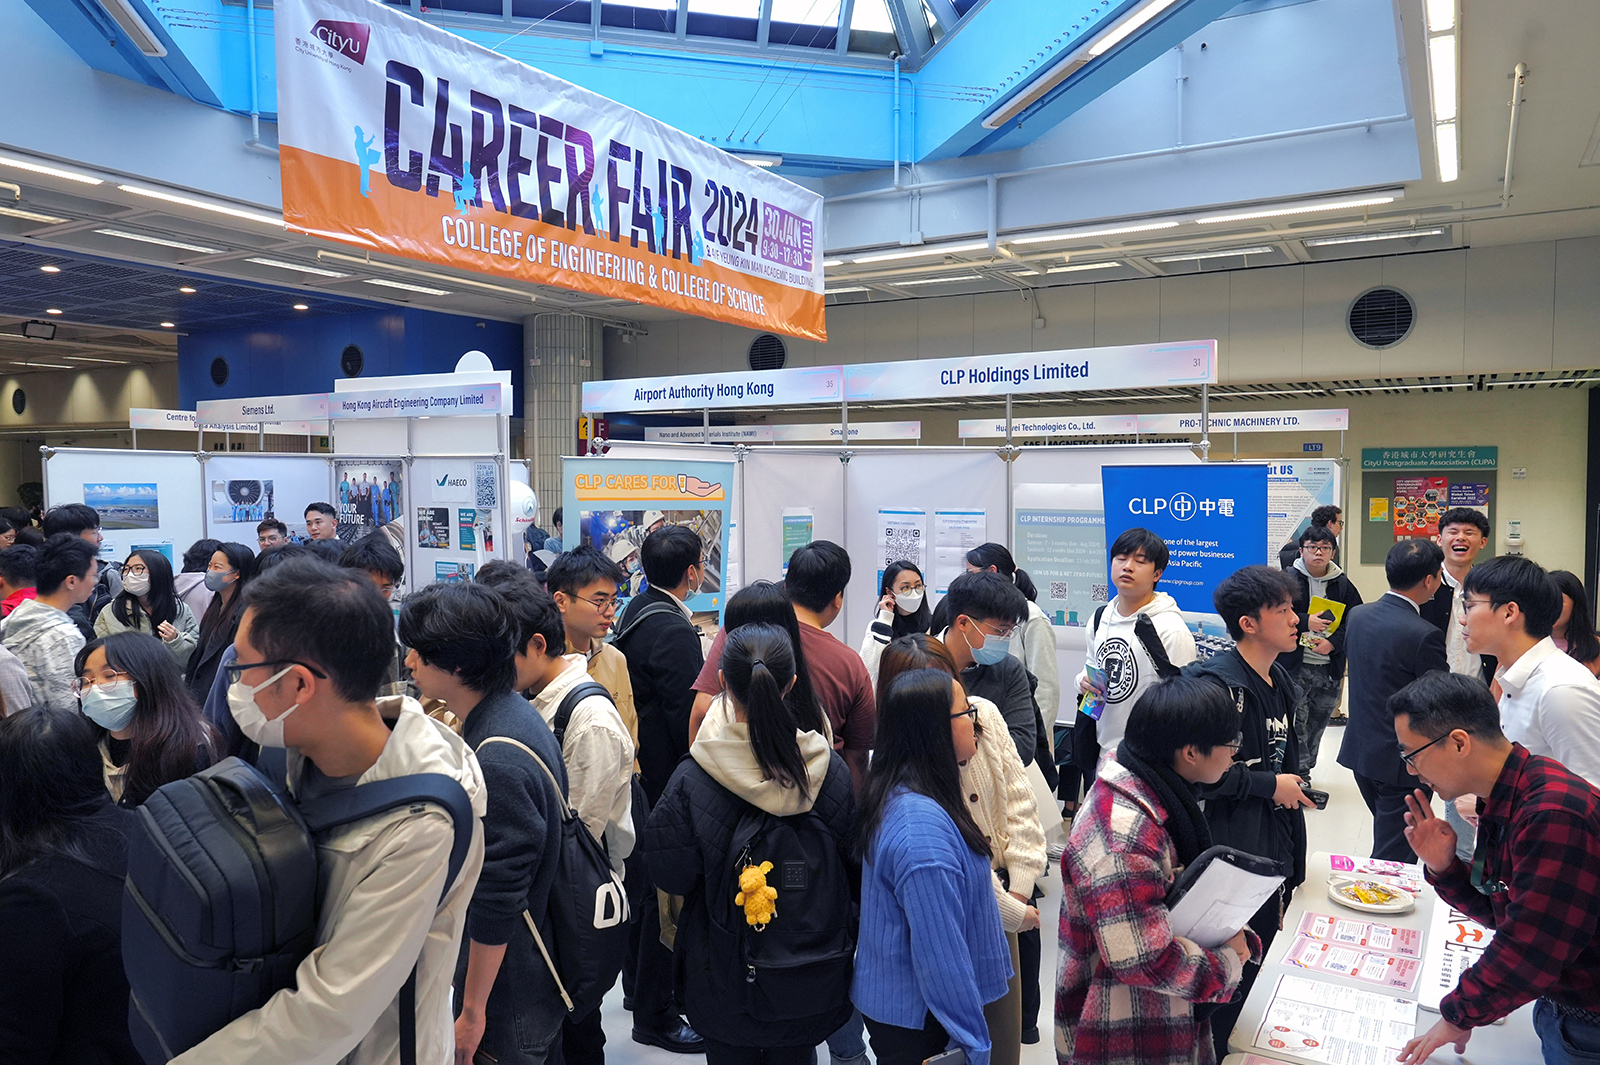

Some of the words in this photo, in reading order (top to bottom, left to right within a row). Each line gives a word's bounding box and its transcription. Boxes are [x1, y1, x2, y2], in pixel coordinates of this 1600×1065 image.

[317, 26, 360, 54] CityU
[384, 59, 598, 238] CAREER
[606, 139, 694, 264] FAIR
[702, 179, 759, 256] 2024
[764, 206, 780, 241] 30
[780, 212, 802, 249] JAN
[441, 215, 523, 260] COLLEGE
[525, 233, 547, 264] OF
[550, 239, 645, 286] ENGINEERING
[648, 263, 659, 290] &
[661, 265, 711, 303] COLLEGE
[712, 281, 726, 306] OF
[726, 285, 767, 317] SCIENCE
[720, 252, 740, 268] YEUNG
[740, 257, 751, 270] KIN
[751, 260, 764, 274] MAN
[764, 264, 789, 282] ACADEMIC
[788, 272, 814, 288] BUILDING
[1193, 358, 1201, 368] 31
[941, 369, 965, 386] CLP
[969, 365, 1030, 385] Holdings
[1033, 361, 1089, 381] Limited
[826, 380, 834, 388] 35
[634, 388, 666, 403] Airport
[668, 384, 714, 401] Authority
[717, 383, 744, 399] Hong
[746, 381, 774, 397] Kong
[342, 401, 356, 413] Hong
[357, 400, 371, 412] Kong
[372, 398, 393, 409] Aircraft
[394, 396, 429, 410] Engineering
[430, 395, 459, 409] Company
[459, 394, 484, 405] Limited
[242, 405, 265, 416] Siemens
[264, 404, 275, 415] Ltd.
[166, 412, 189, 422] Centre
[1179, 418, 1232, 428] PRO-TCHNIC
[1233, 417, 1281, 427] MACHINERY
[1283, 416, 1300, 426] LTD.
[236, 423, 258, 431] Limited
[830, 428, 859, 436] Smaone
[1022, 421, 1067, 433] Technologies
[1067, 422, 1081, 431] Co.,
[1082, 421, 1096, 430] Ltd.
[1382, 450, 1476, 460] 香港城市大學研究生會
[1383, 459, 1429, 468] Postgraduate
[1470, 458, 1496, 467] (CUPA)
[1280, 465, 1293, 475] US
[447, 479, 468, 487] HAECO
[575, 473, 603, 490] CLP
[605, 474, 649, 491] CARES
[651, 475, 678, 491] FOR
[339, 503, 357, 514] YOUR
[1129, 498, 1167, 515] CLP
[1199, 498, 1235, 517] 中電
[340, 513, 365, 524] FUTURE
[1067, 516, 1105, 524] PROGRAMME
[1184, 539, 1195, 547] the
[1196, 539, 1219, 548] largest
[1178, 551, 1198, 559] power
[1199, 550, 1235, 559] businesses
[1167, 560, 1180, 568] Asia
[1181, 560, 1202, 568] Pacific
